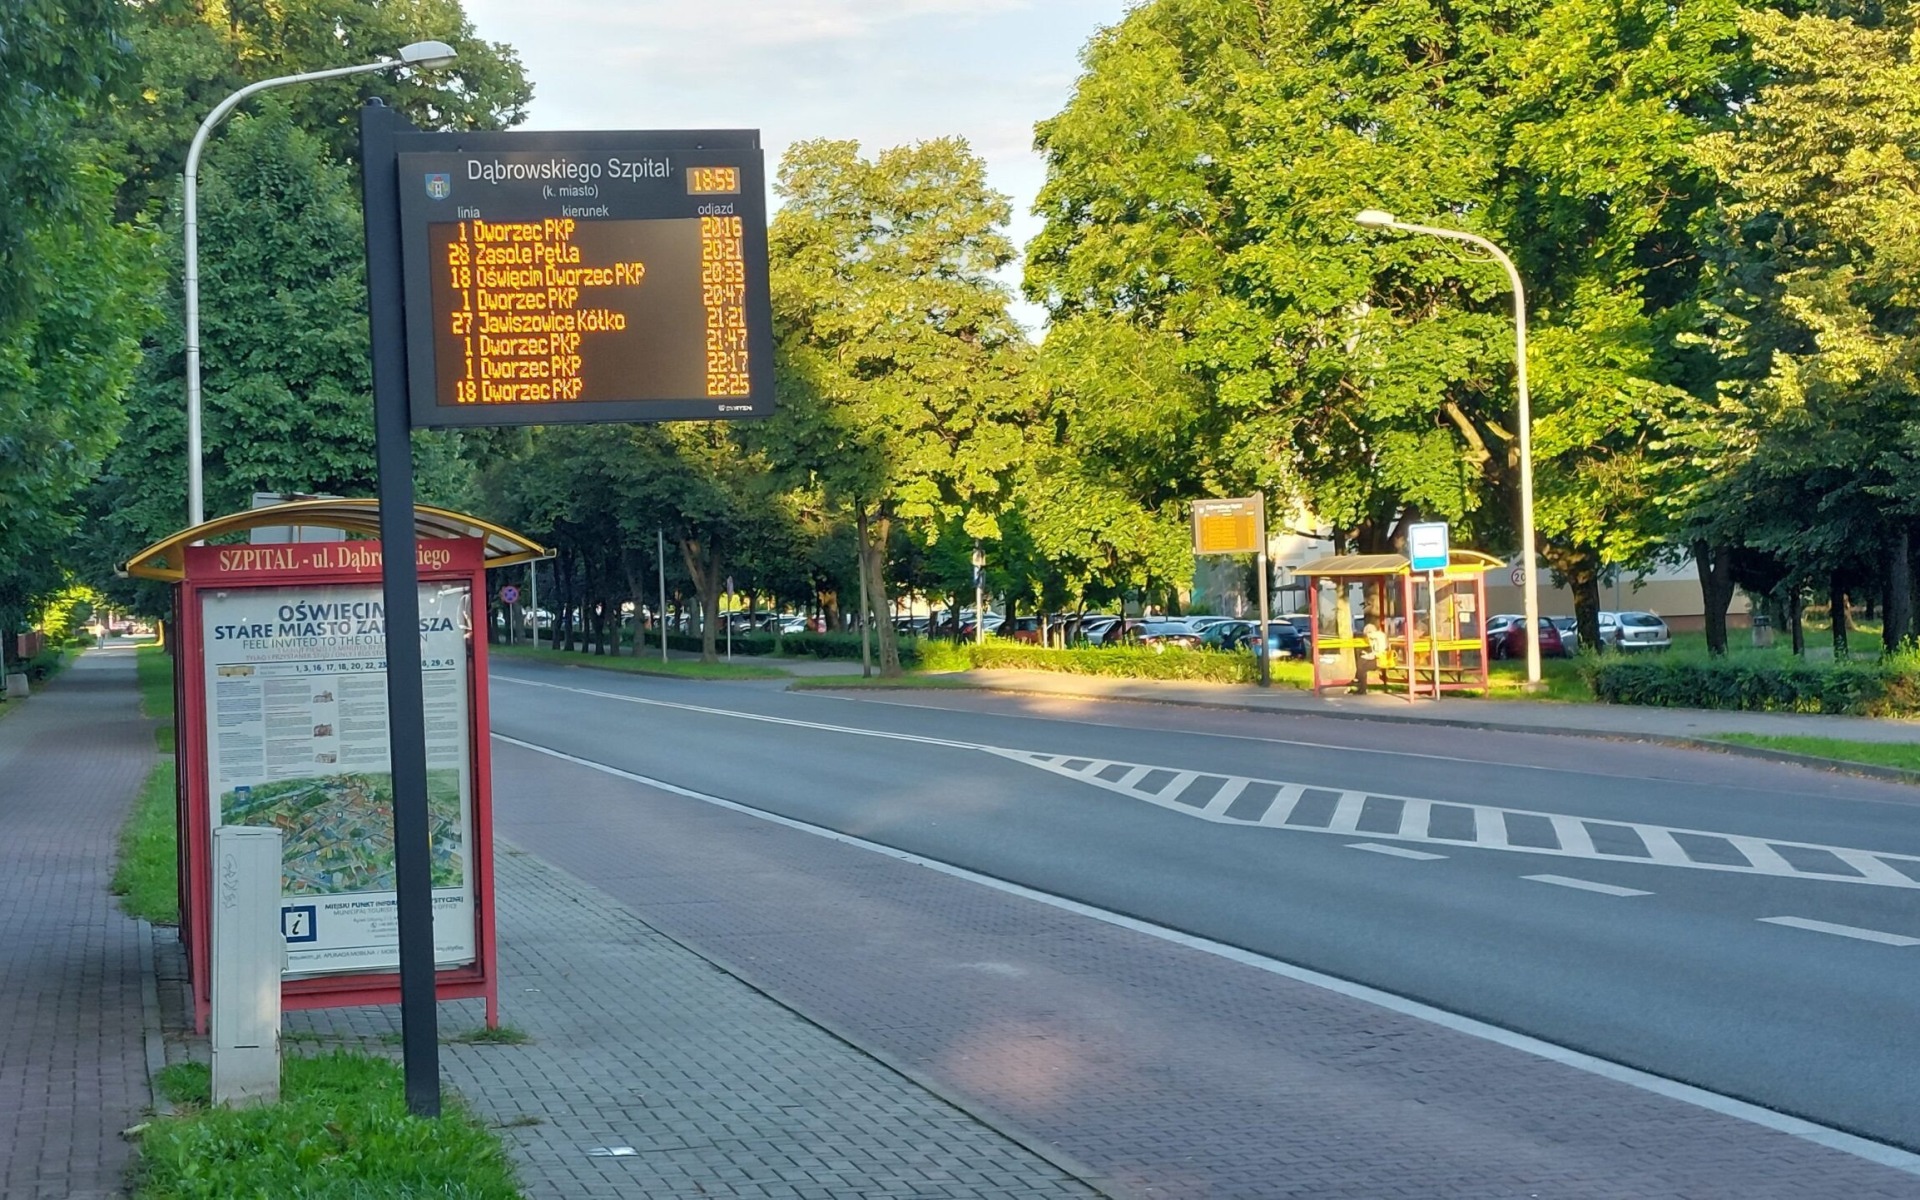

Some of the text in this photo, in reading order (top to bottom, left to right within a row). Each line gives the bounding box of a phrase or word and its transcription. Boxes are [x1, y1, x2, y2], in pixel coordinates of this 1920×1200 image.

[467, 157, 670, 184] Dąbrowskiego Szpital
[693, 168, 736, 191] 18:59
[543, 184, 599, 199] (k. miasto)
[457, 203, 734, 218] linia kierunek odjazd
[459, 216, 743, 242] 1 Dworzec PKP 20:16
[475, 242, 534, 265] Zasole
[534, 242, 581, 265] Pętla
[702, 239, 744, 261] 20:21
[451, 262, 745, 290] 18 Oświęcim Dworzec PKP 20:33
[462, 284, 746, 311] 1 Dworzec PKP 20:47
[451, 306, 746, 335] 27 Jawiszowice Kółko 21:21
[464, 329, 748, 357] 1 Dworzec PKP 21:47
[465, 351, 749, 380] 1 Dworzec PKP 22:17
[457, 374, 750, 403] 18 Dworzec PKP 22:25
[219, 548, 299, 572] SZPITAL
[312, 548, 334, 568] ul.
[214, 624, 273, 640] STARE
[278, 620, 351, 637] MIASTO
[242, 639, 269, 650] FEEL
[271, 637, 318, 649] INVITED
[321, 636, 337, 647] TO
[339, 635, 361, 646] THE
